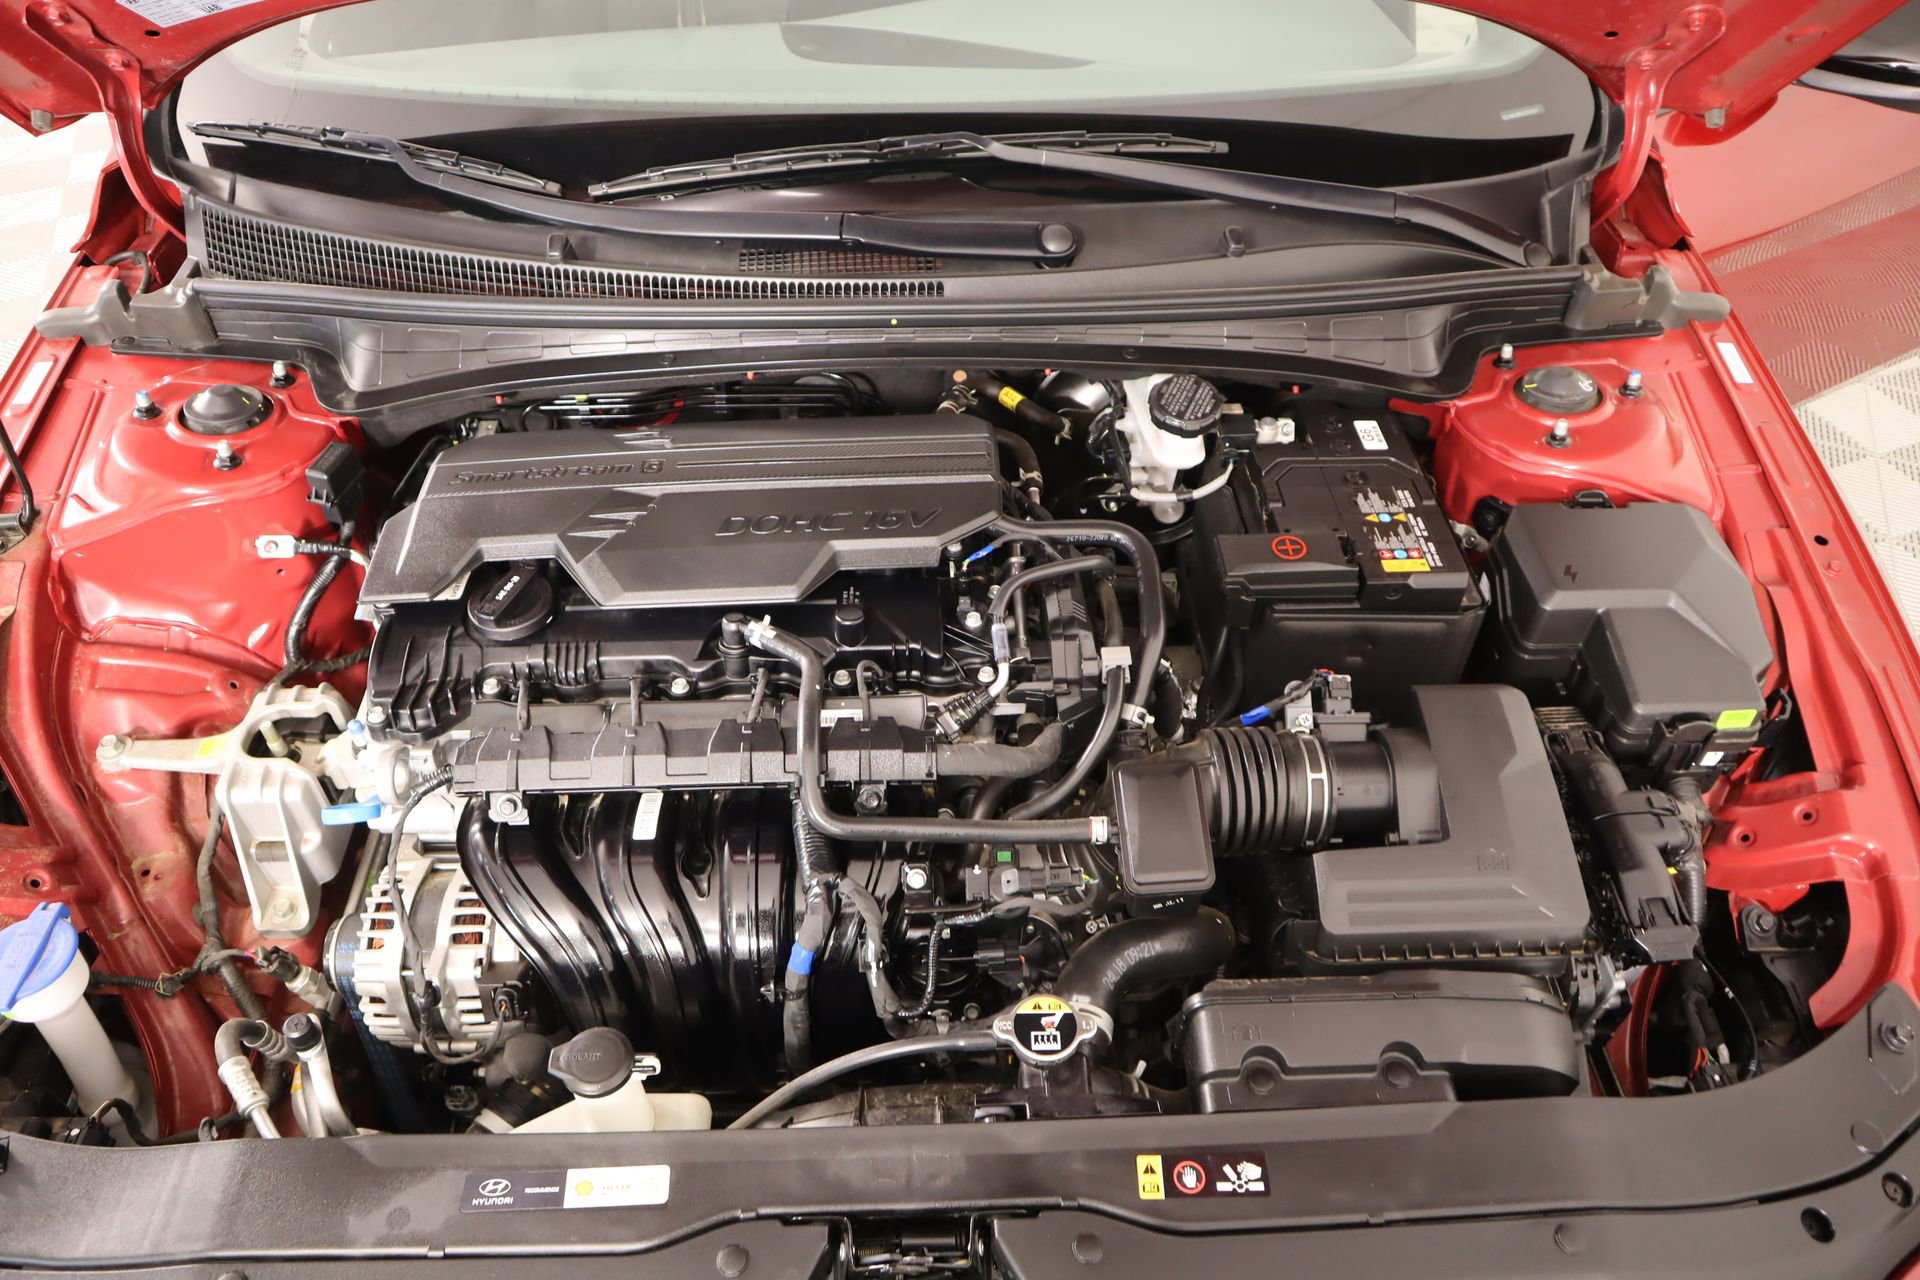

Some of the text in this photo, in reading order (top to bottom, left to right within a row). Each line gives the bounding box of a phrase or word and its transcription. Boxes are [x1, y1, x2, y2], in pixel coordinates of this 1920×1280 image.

[448, 464, 634, 484] Smartstream
[715, 507, 943, 536] DOHC 16V
[472, 1196, 514, 1206] HYUNDAI
